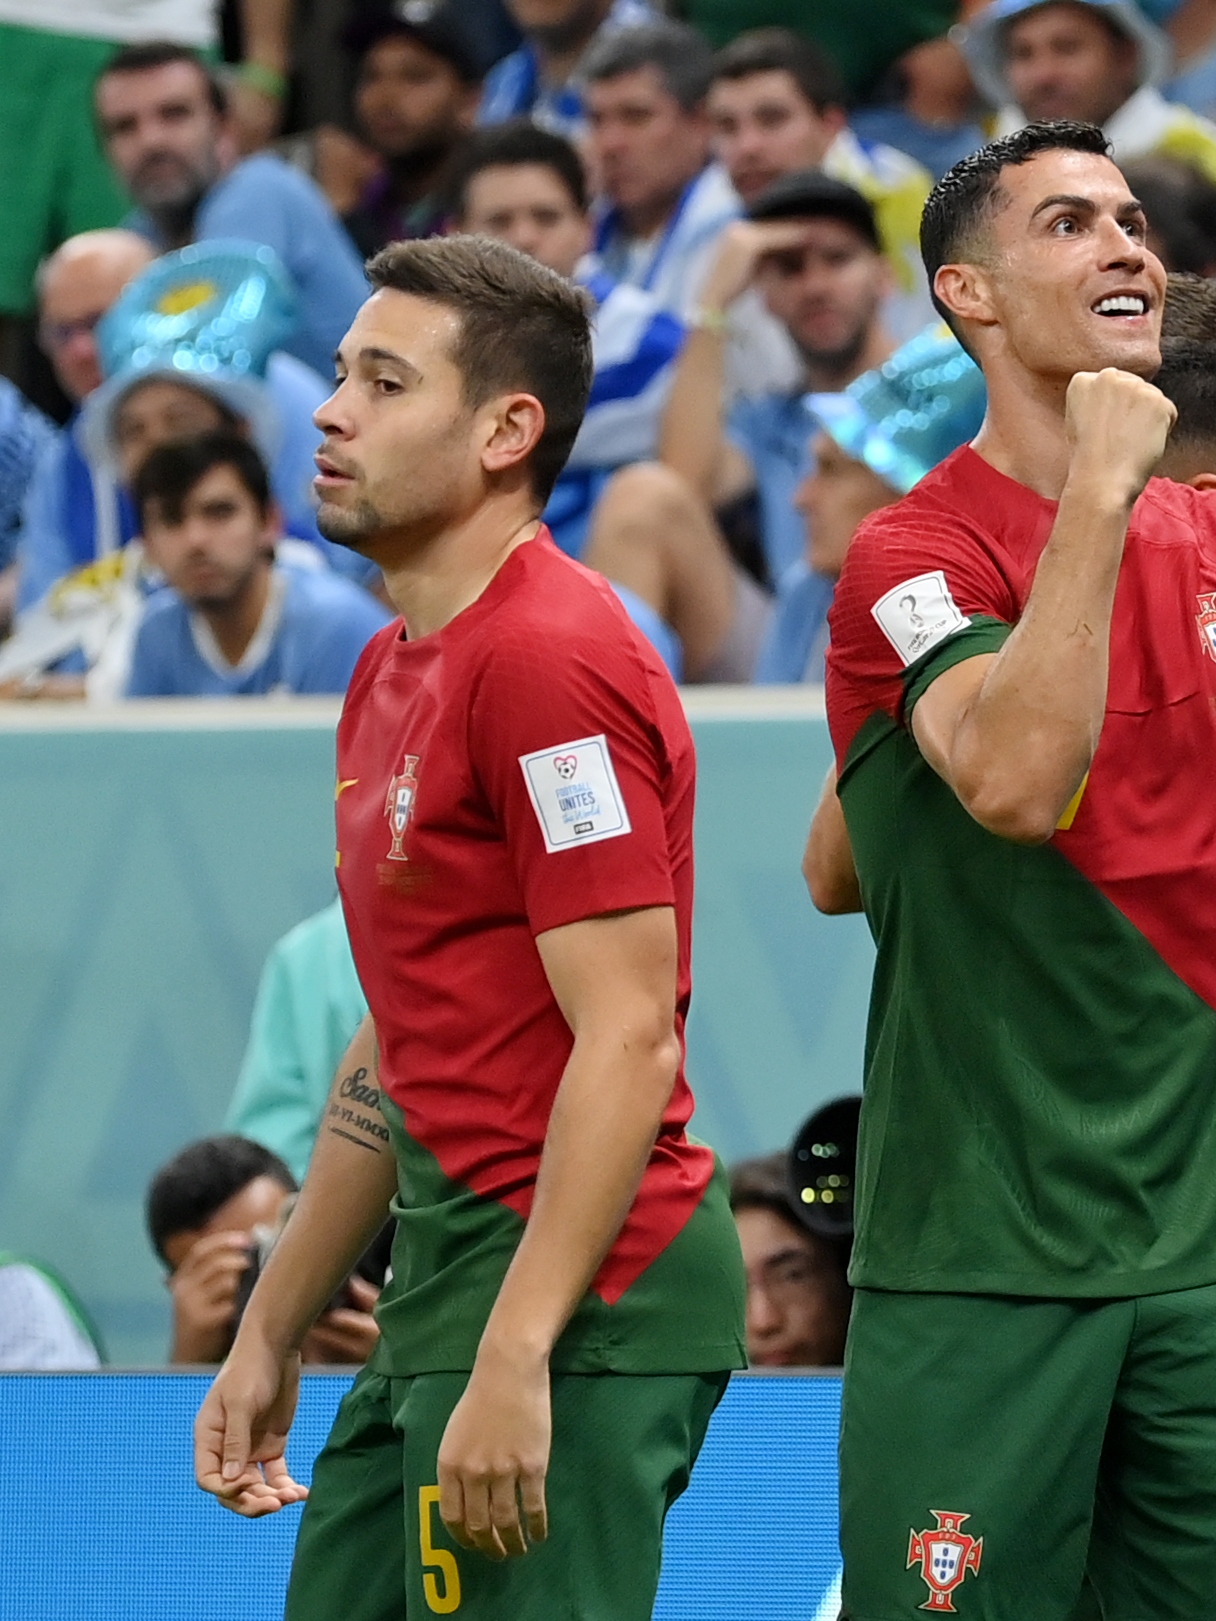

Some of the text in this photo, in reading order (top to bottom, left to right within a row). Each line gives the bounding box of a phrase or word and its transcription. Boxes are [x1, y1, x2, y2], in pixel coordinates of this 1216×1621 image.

[555, 782, 592, 798] FOOTBALL
[559, 791, 596, 812] UNITES
[419, 1485, 461, 1614] 5
